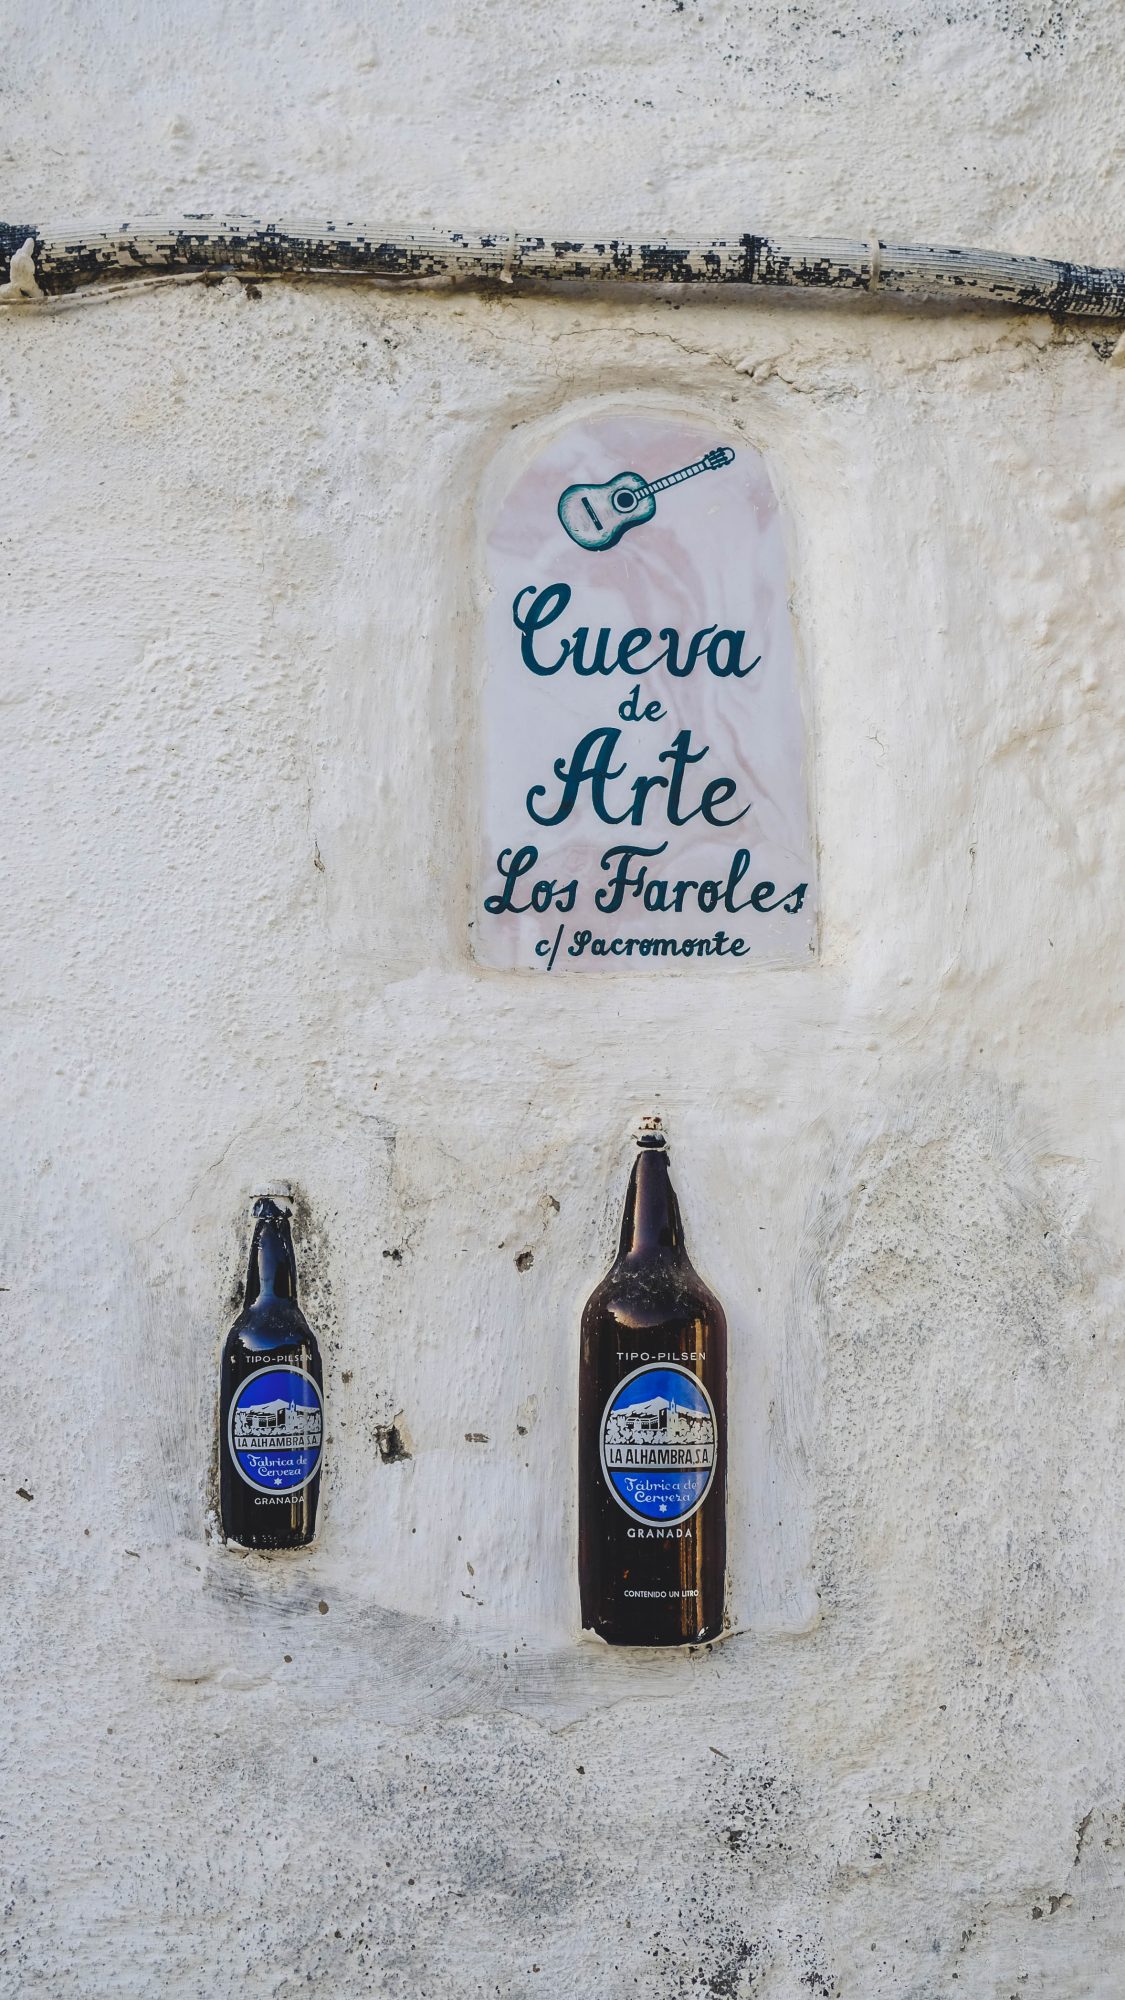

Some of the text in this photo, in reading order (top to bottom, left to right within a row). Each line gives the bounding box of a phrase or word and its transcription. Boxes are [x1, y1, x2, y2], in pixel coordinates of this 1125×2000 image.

[512, 582, 762, 678] Cueva
[618, 684, 668, 722] de
[526, 727, 751, 826] Arte
[484, 841, 808, 914] Los Faroles
[567, 930, 751, 957] Sacromonte
[246, 1354, 312, 1363] TIPO-PILSEN
[616, 1352, 706, 1360] TIPO-PILSEN
[238, 1438, 248, 1447] LA
[296, 1455, 307, 1465] de
[610, 1448, 622, 1463] LA
[258, 1466, 301, 1477] Cerveza
[683, 1480, 697, 1490] de
[254, 1496, 305, 1505] GRANADA
[634, 1491, 690, 1503] Cerveza
[627, 1528, 692, 1538] GRANADA
[624, 1589, 699, 1598] CONTENIDO UN LITRO
